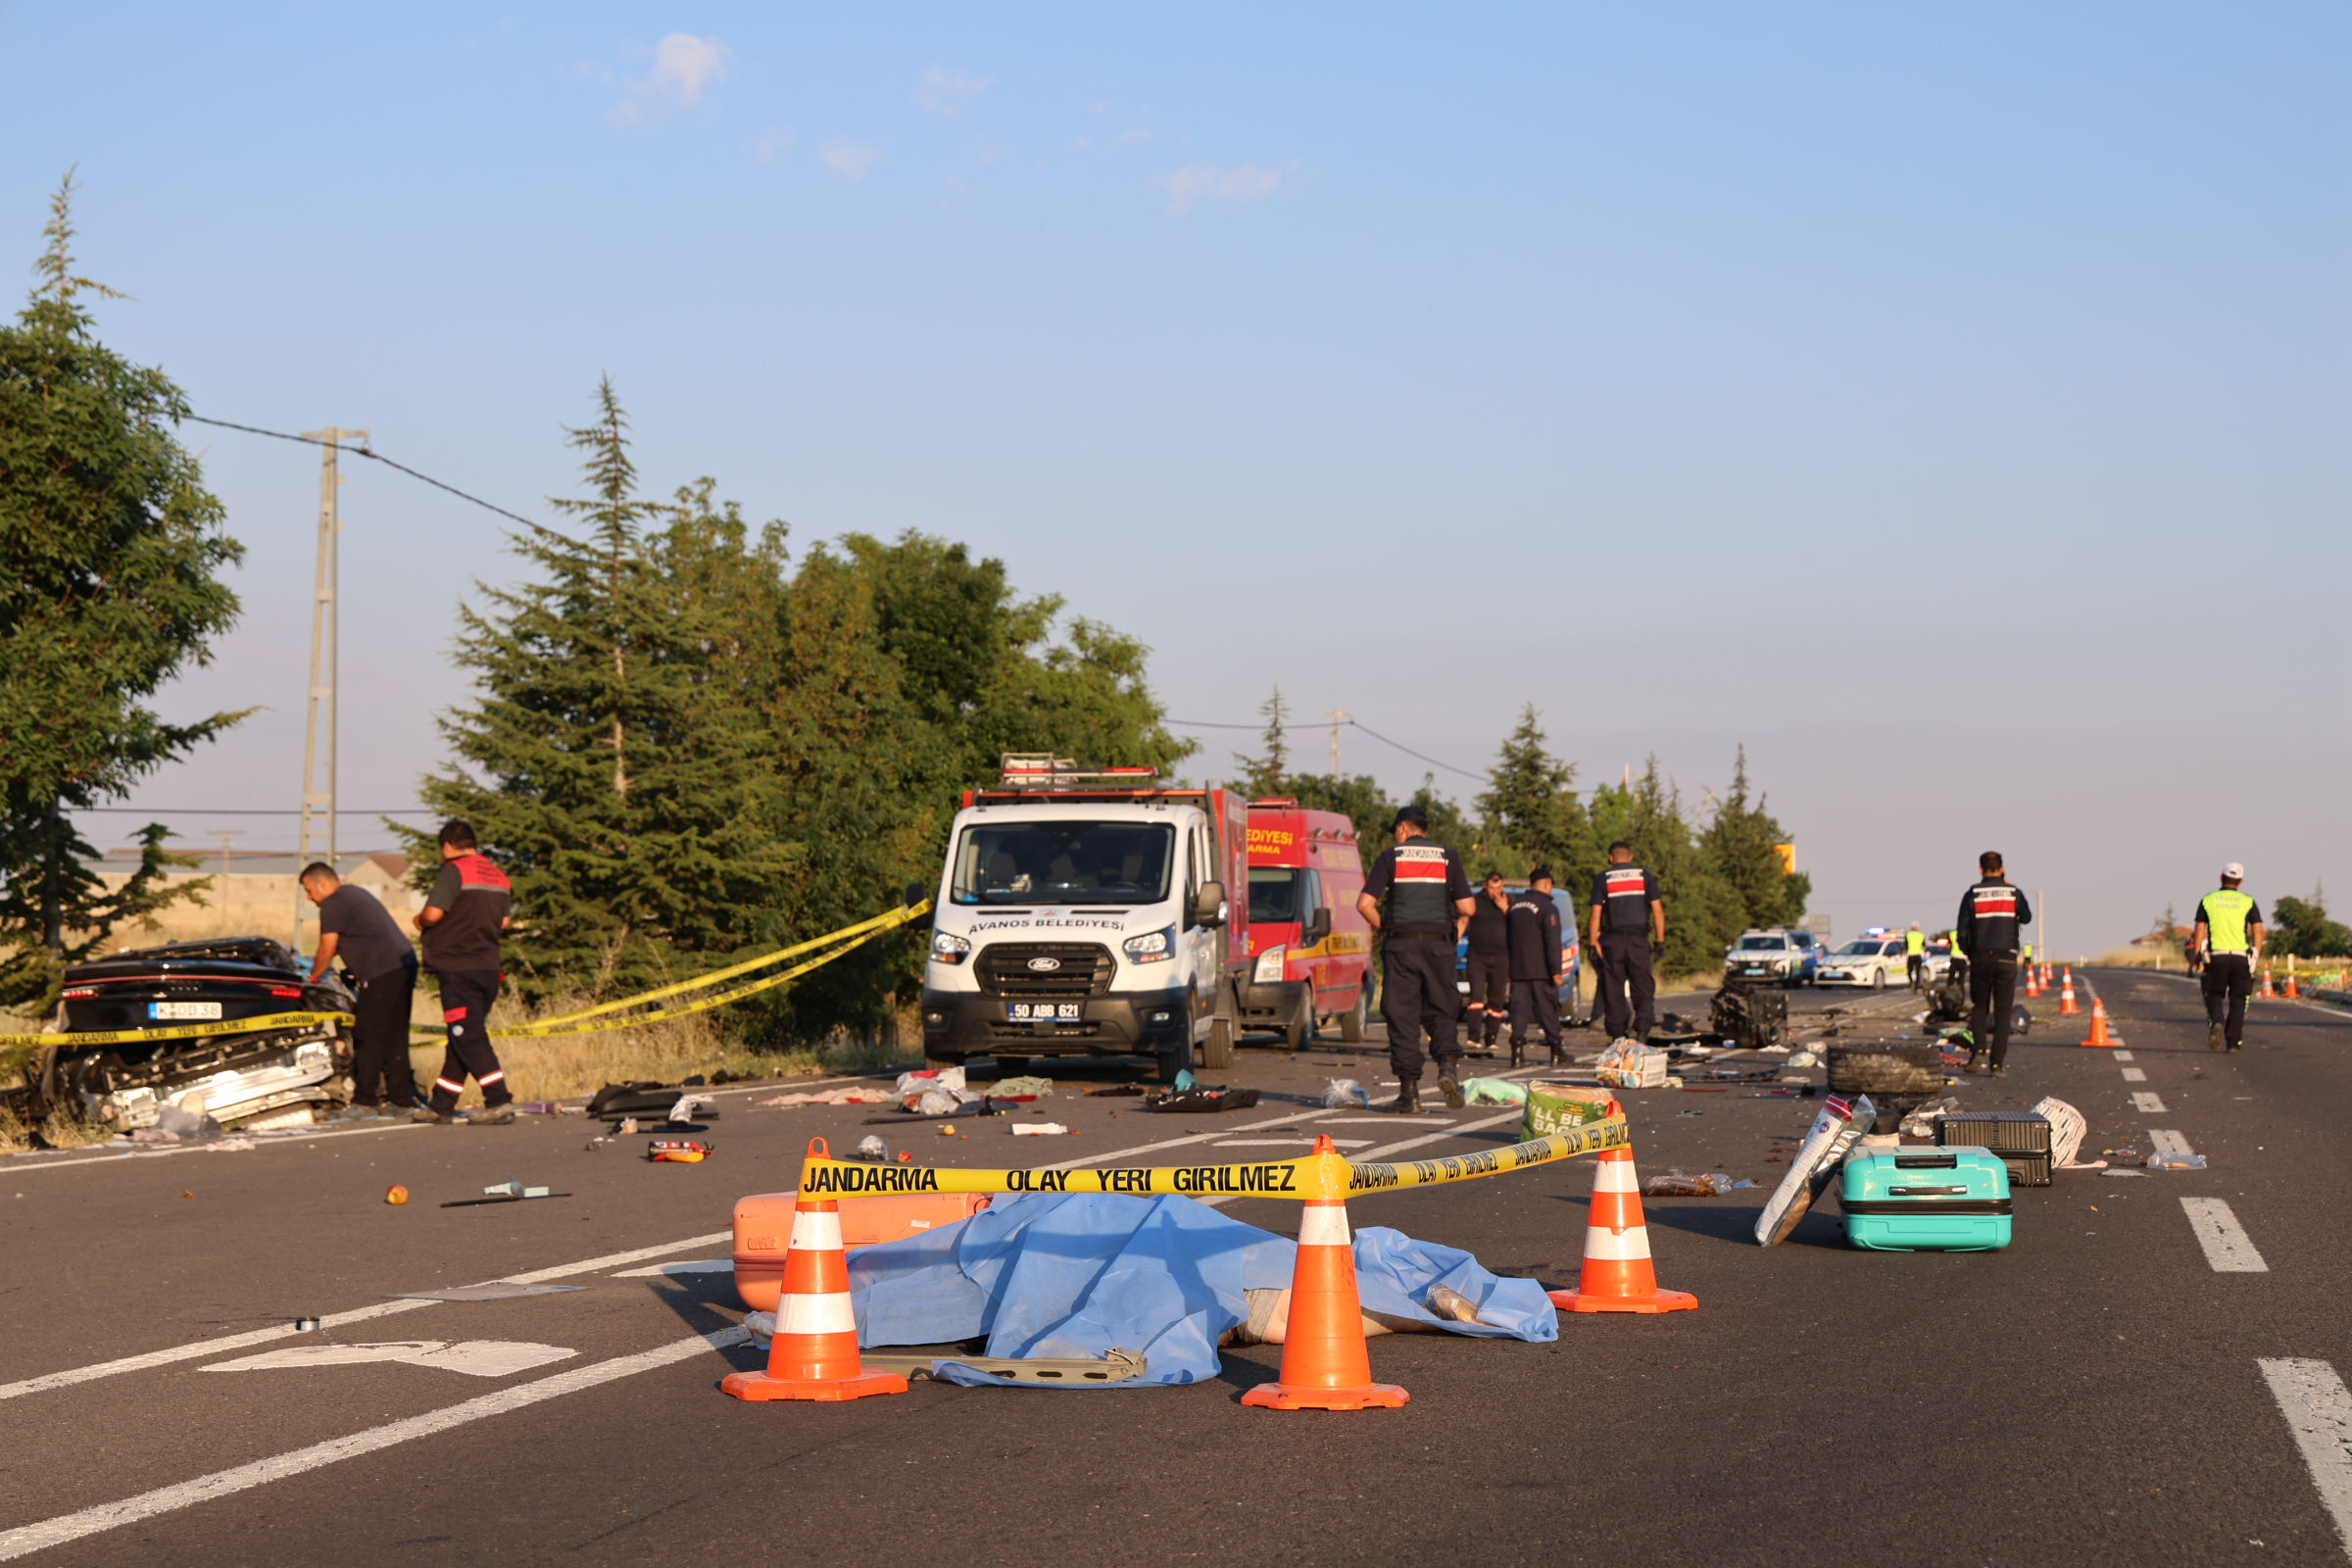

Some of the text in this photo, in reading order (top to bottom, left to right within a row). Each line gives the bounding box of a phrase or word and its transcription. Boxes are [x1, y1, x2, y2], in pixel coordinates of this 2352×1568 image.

[968, 919, 1030, 936] AVANOS
[201, 1003, 220, 1015] 38
[1014, 1004, 1079, 1017] 50 ABB 621
[1560, 1112, 1584, 1127] BE
[804, 1164, 1297, 1193] JANDARMA OLAY YERI GIRILMEZ
[1349, 1164, 1398, 1190] JANDARMA
